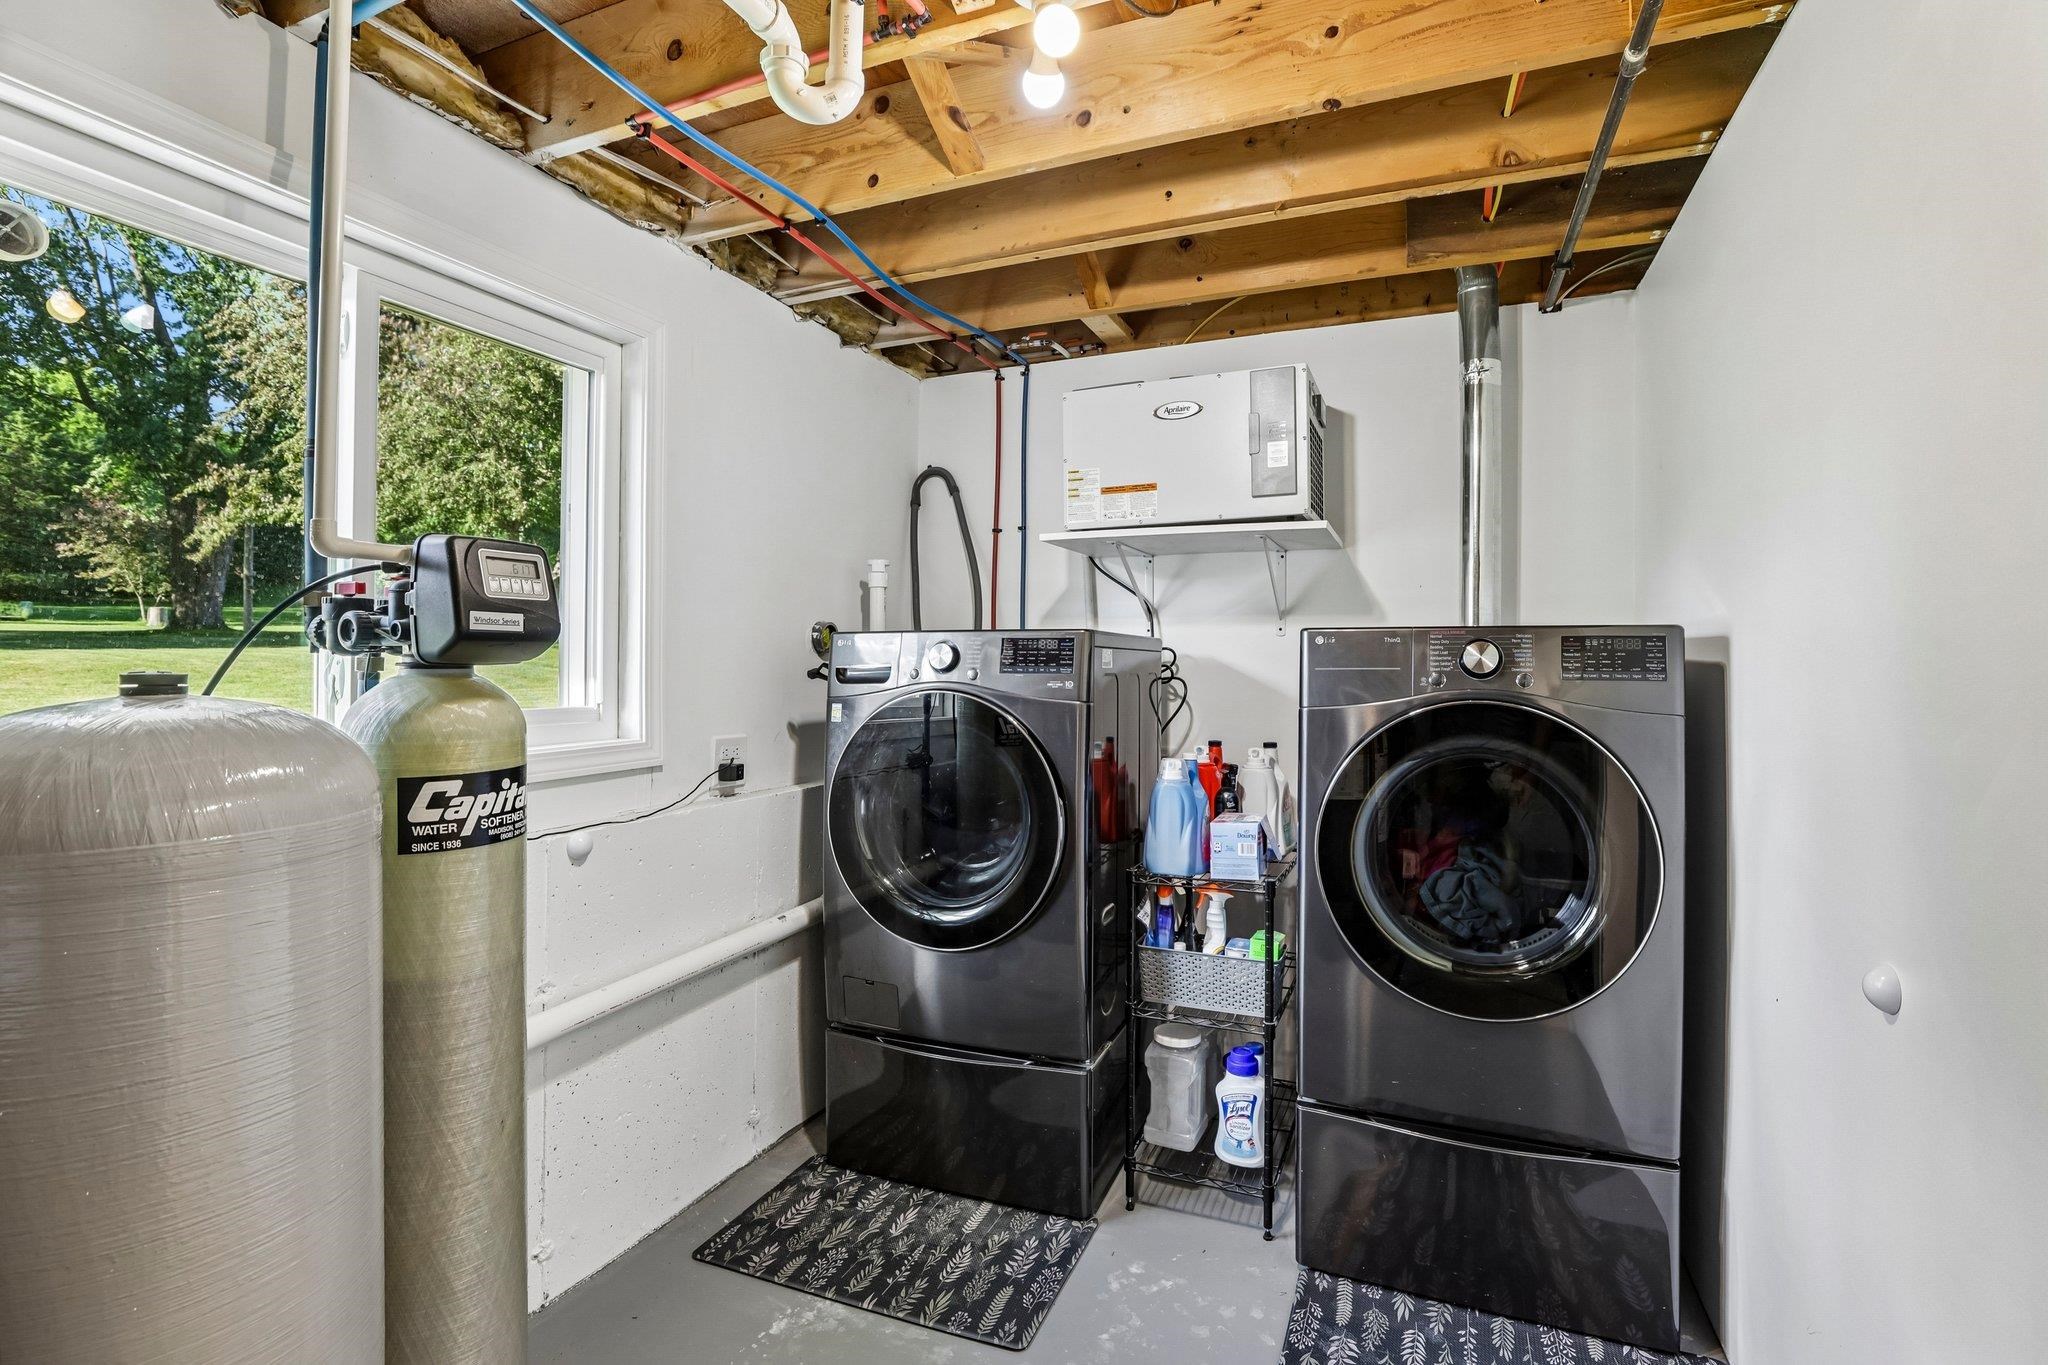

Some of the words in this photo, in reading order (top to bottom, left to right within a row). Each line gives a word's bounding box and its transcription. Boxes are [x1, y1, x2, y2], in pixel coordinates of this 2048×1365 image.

[1163, 405, 1191, 416] Aprilaire
[473, 616, 500, 625] Windsor
[501, 617, 520, 627] Series
[1384, 636, 1401, 644] ThinQ
[407, 777, 527, 837] Capita
[480, 810, 524, 830] SOFTENER
[411, 823, 458, 837] WATER
[1237, 832, 1256, 841] Downy
[411, 841, 440, 853] SINCE
[441, 839, 462, 850] 1936
[1229, 1103, 1251, 1115] Lysol
